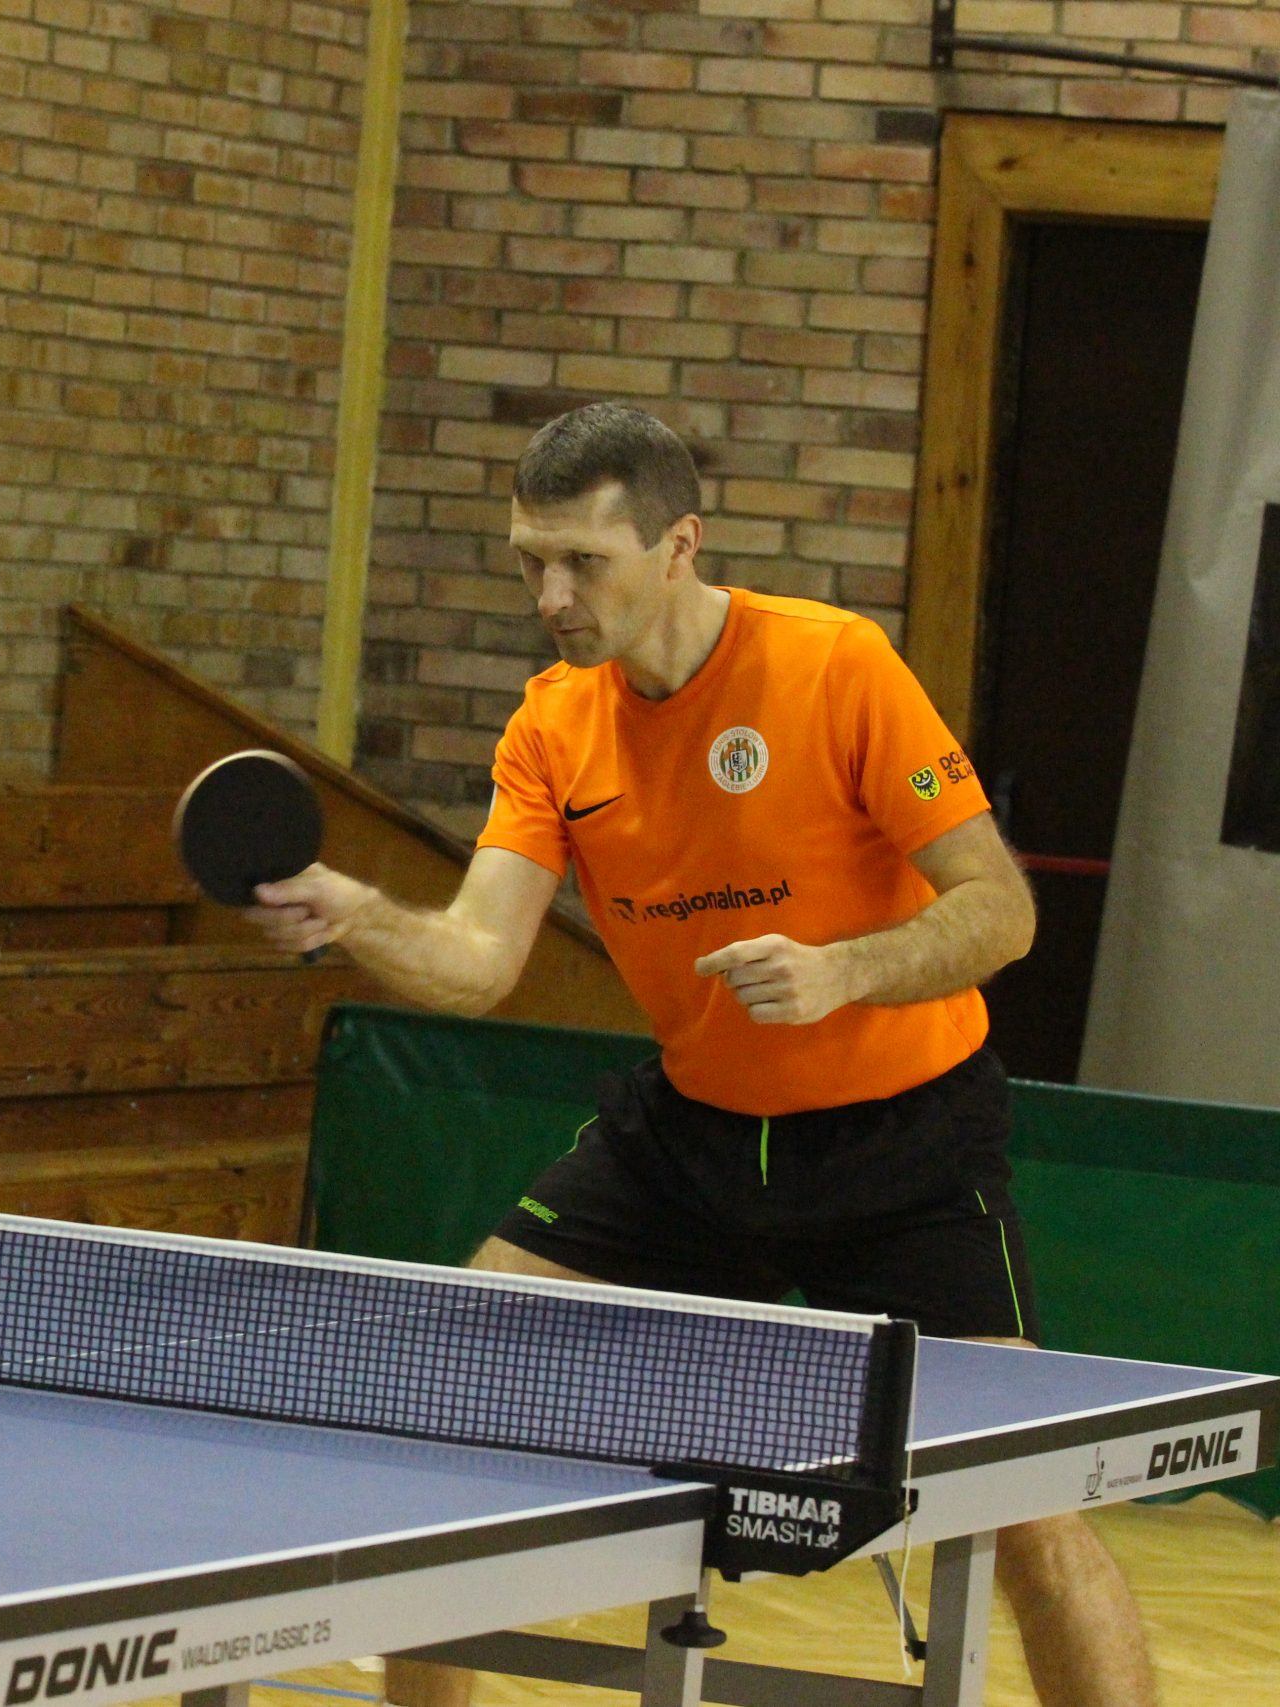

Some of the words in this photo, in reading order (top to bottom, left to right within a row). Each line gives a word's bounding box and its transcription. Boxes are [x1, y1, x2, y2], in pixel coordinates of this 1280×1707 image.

[646, 879, 792, 921] regionalna.pl
[1146, 1426, 1244, 1480] DONIC
[728, 1486, 841, 1525] TIBHAR
[726, 1514, 813, 1546] SMASH
[3, 1628, 177, 1706] DONIC
[180, 1635, 252, 1670] WALDNER
[254, 1622, 310, 1656] CLASSIC
[312, 1618, 332, 1644] 25
